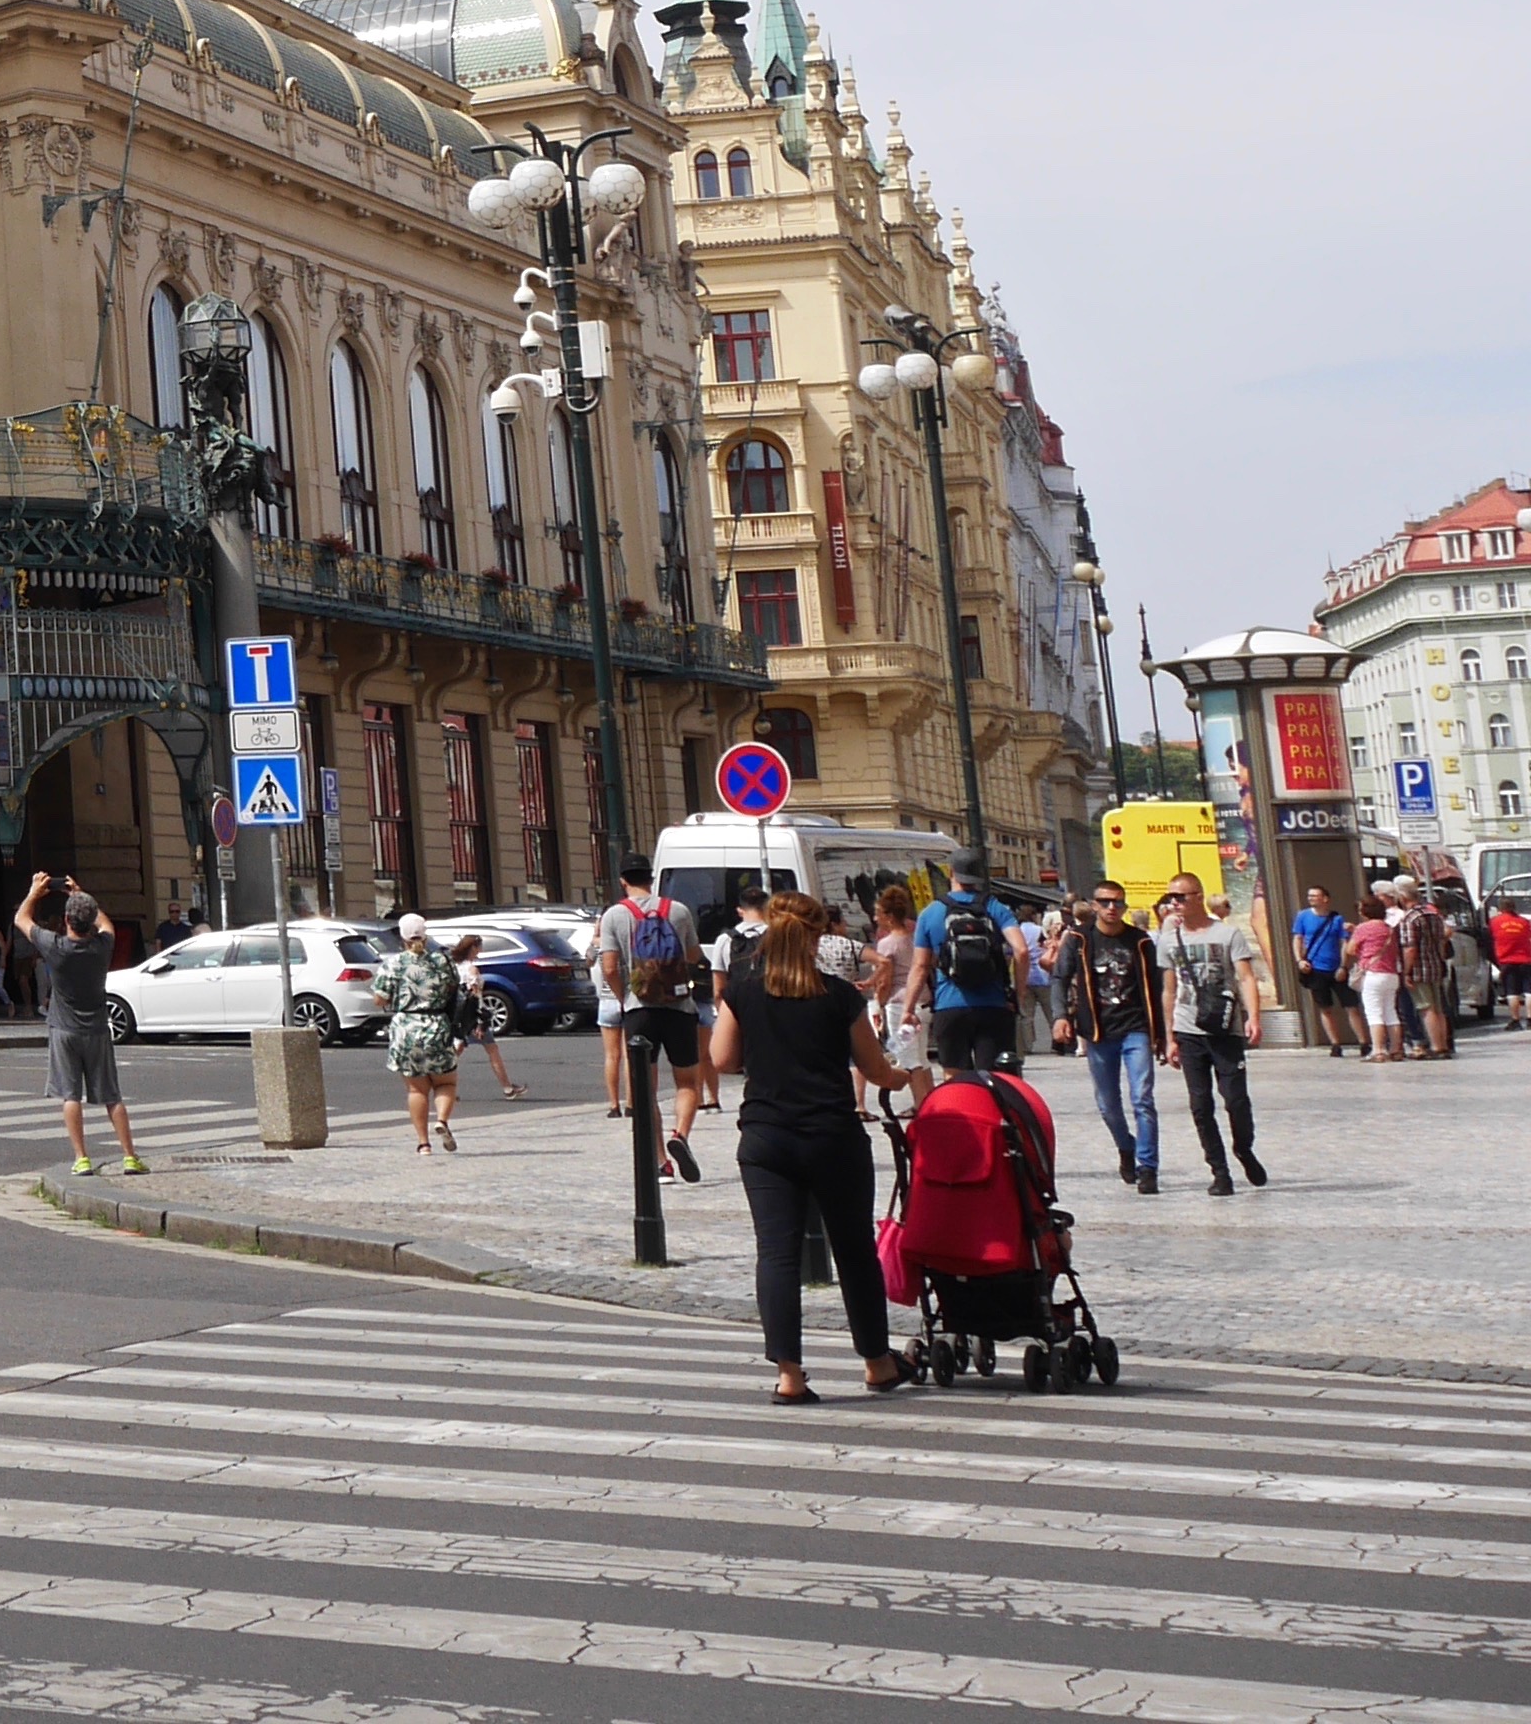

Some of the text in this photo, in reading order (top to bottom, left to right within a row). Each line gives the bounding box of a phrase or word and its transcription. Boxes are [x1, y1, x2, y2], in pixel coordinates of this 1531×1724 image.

[252, 715, 277, 725] MIMO
[1425, 648, 1465, 810] HOTEL
[1401, 764, 1423, 797] P
[1147, 824, 1185, 834] MARTIN
